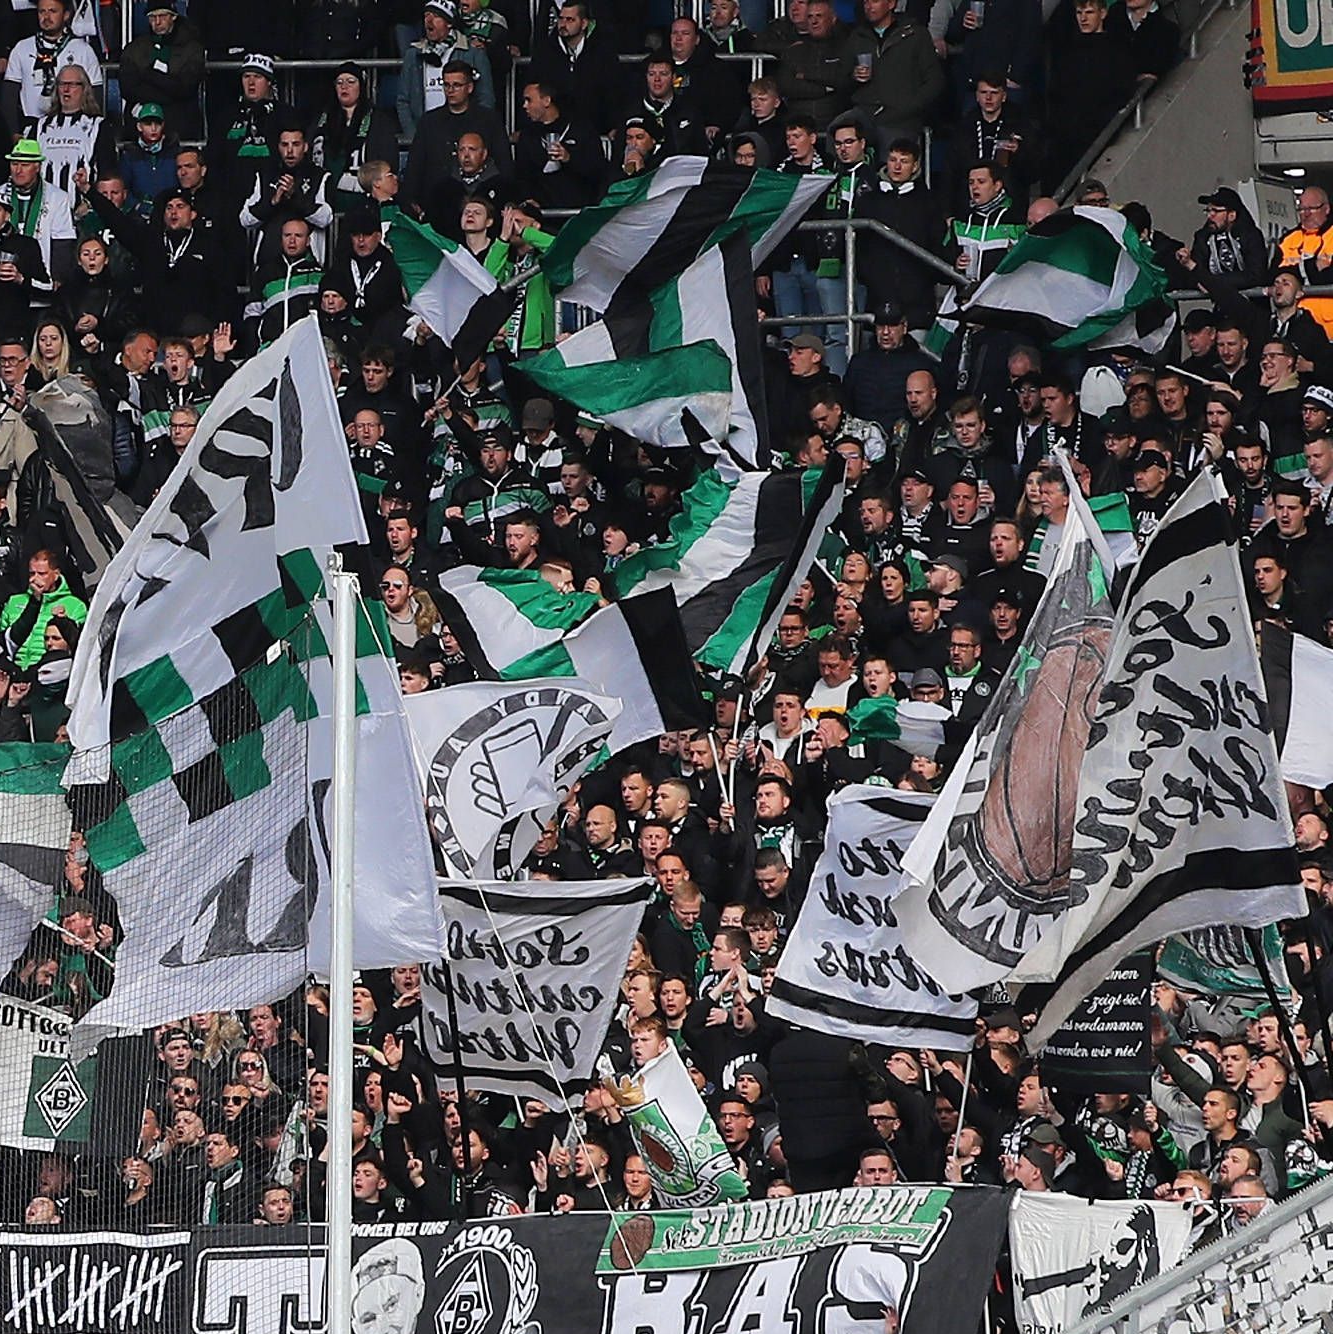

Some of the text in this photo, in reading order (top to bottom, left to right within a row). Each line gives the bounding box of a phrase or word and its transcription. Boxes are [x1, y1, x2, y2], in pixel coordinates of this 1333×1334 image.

[1074, 1018, 1144, 1032] verdammen
[1091, 1045, 1112, 1057] wir
[1115, 1041, 1142, 1057] nie!
[688, 1189, 931, 1249] STADIONVERBOT
[350, 1220, 450, 1238] MMER BEI UNS
[453, 1225, 512, 1250] 1900
